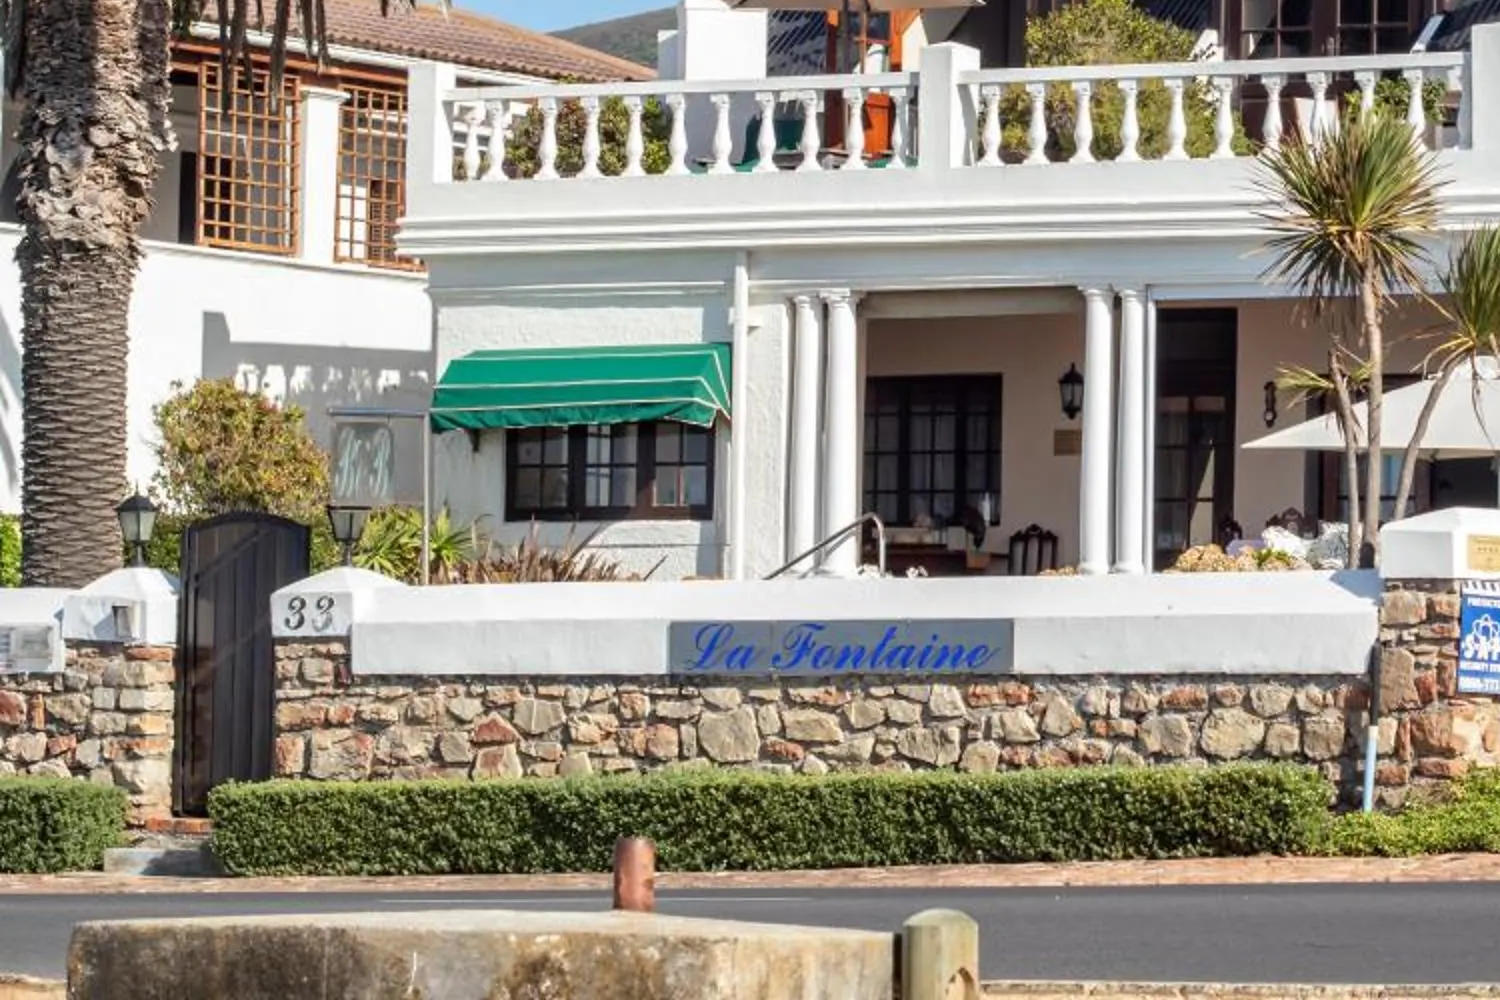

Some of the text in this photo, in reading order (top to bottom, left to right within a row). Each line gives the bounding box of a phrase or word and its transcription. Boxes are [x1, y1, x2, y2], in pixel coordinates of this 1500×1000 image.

[284, 595, 335, 632] 33
[686, 622, 1000, 671] La Fontaine
